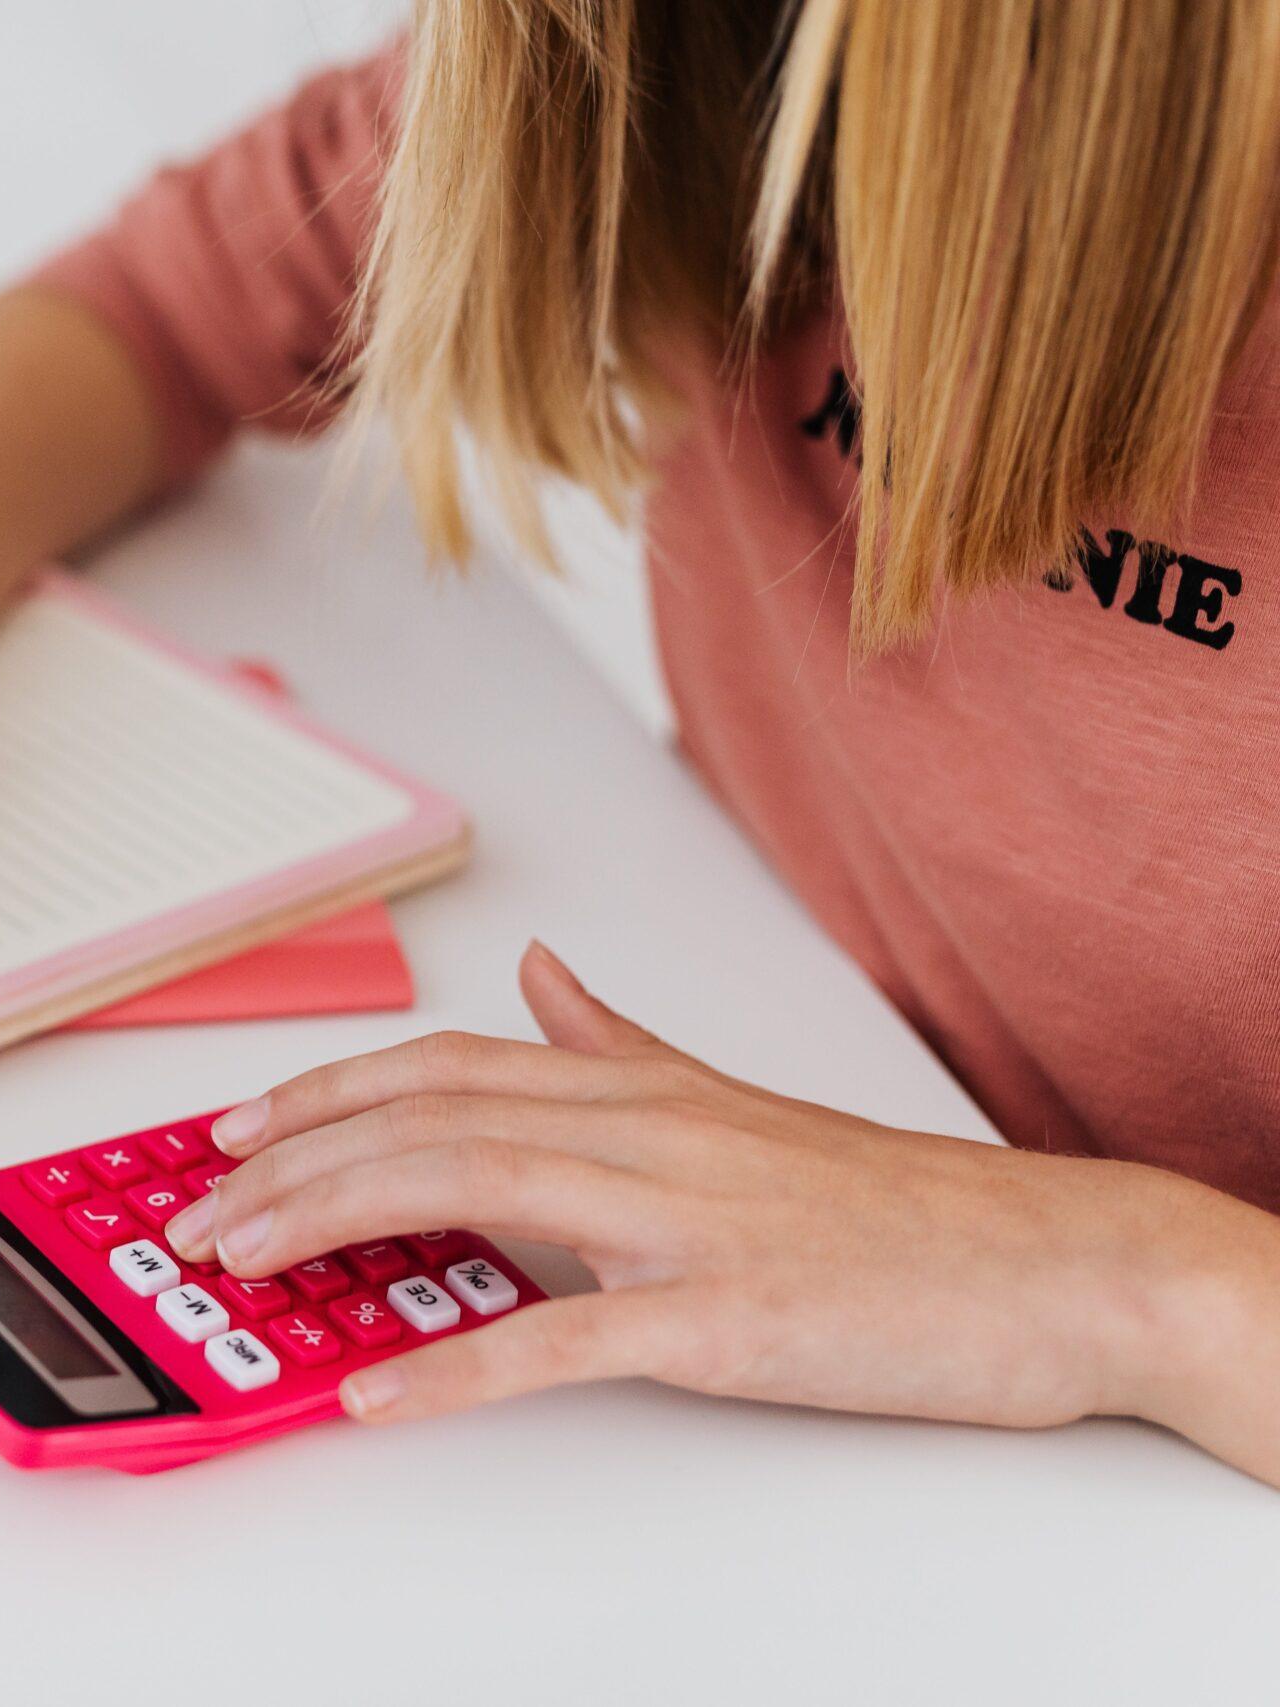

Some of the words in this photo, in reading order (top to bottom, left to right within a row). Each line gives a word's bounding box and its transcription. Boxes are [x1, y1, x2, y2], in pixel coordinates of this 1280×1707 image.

[147, 1192, 176, 1207] 9
[130, 1249, 163, 1273] M+
[302, 1260, 326, 1272] 4
[240, 1282, 270, 1294] 7
[406, 1284, 438, 1305] CE
[350, 1303, 384, 1325] %
[226, 1337, 261, 1365] MRC
